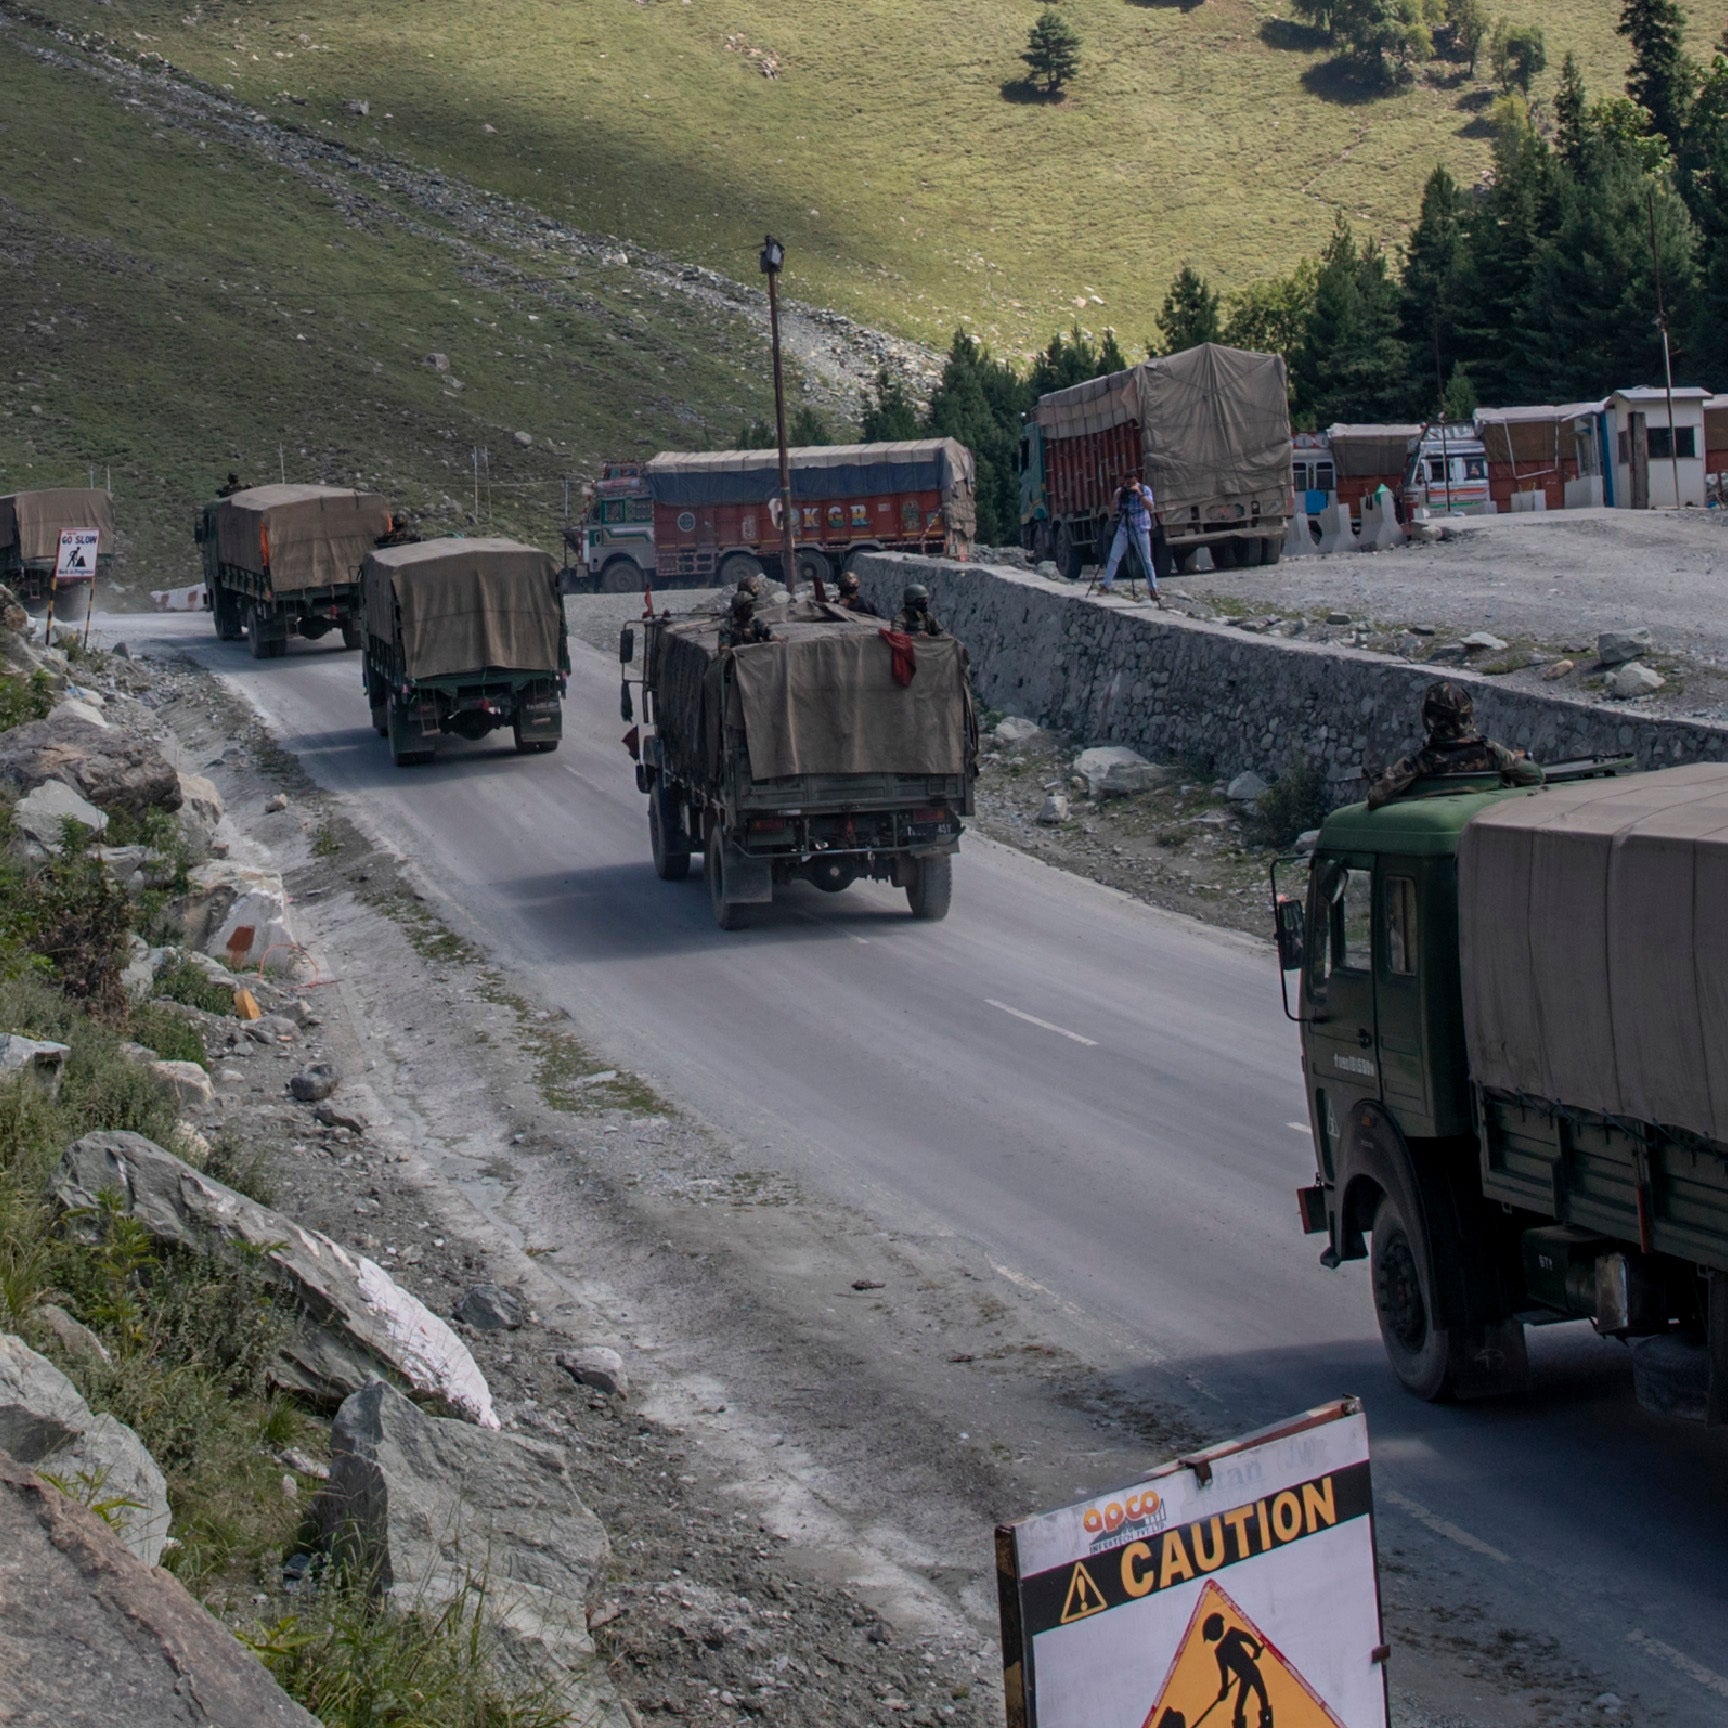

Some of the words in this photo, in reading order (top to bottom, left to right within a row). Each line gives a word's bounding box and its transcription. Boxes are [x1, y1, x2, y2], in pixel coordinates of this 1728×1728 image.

[62, 536, 73, 544] GO
[75, 536, 97, 544] SLOW
[1083, 1490, 1161, 1534] apco
[1121, 1477, 1337, 1597] CAUTION
